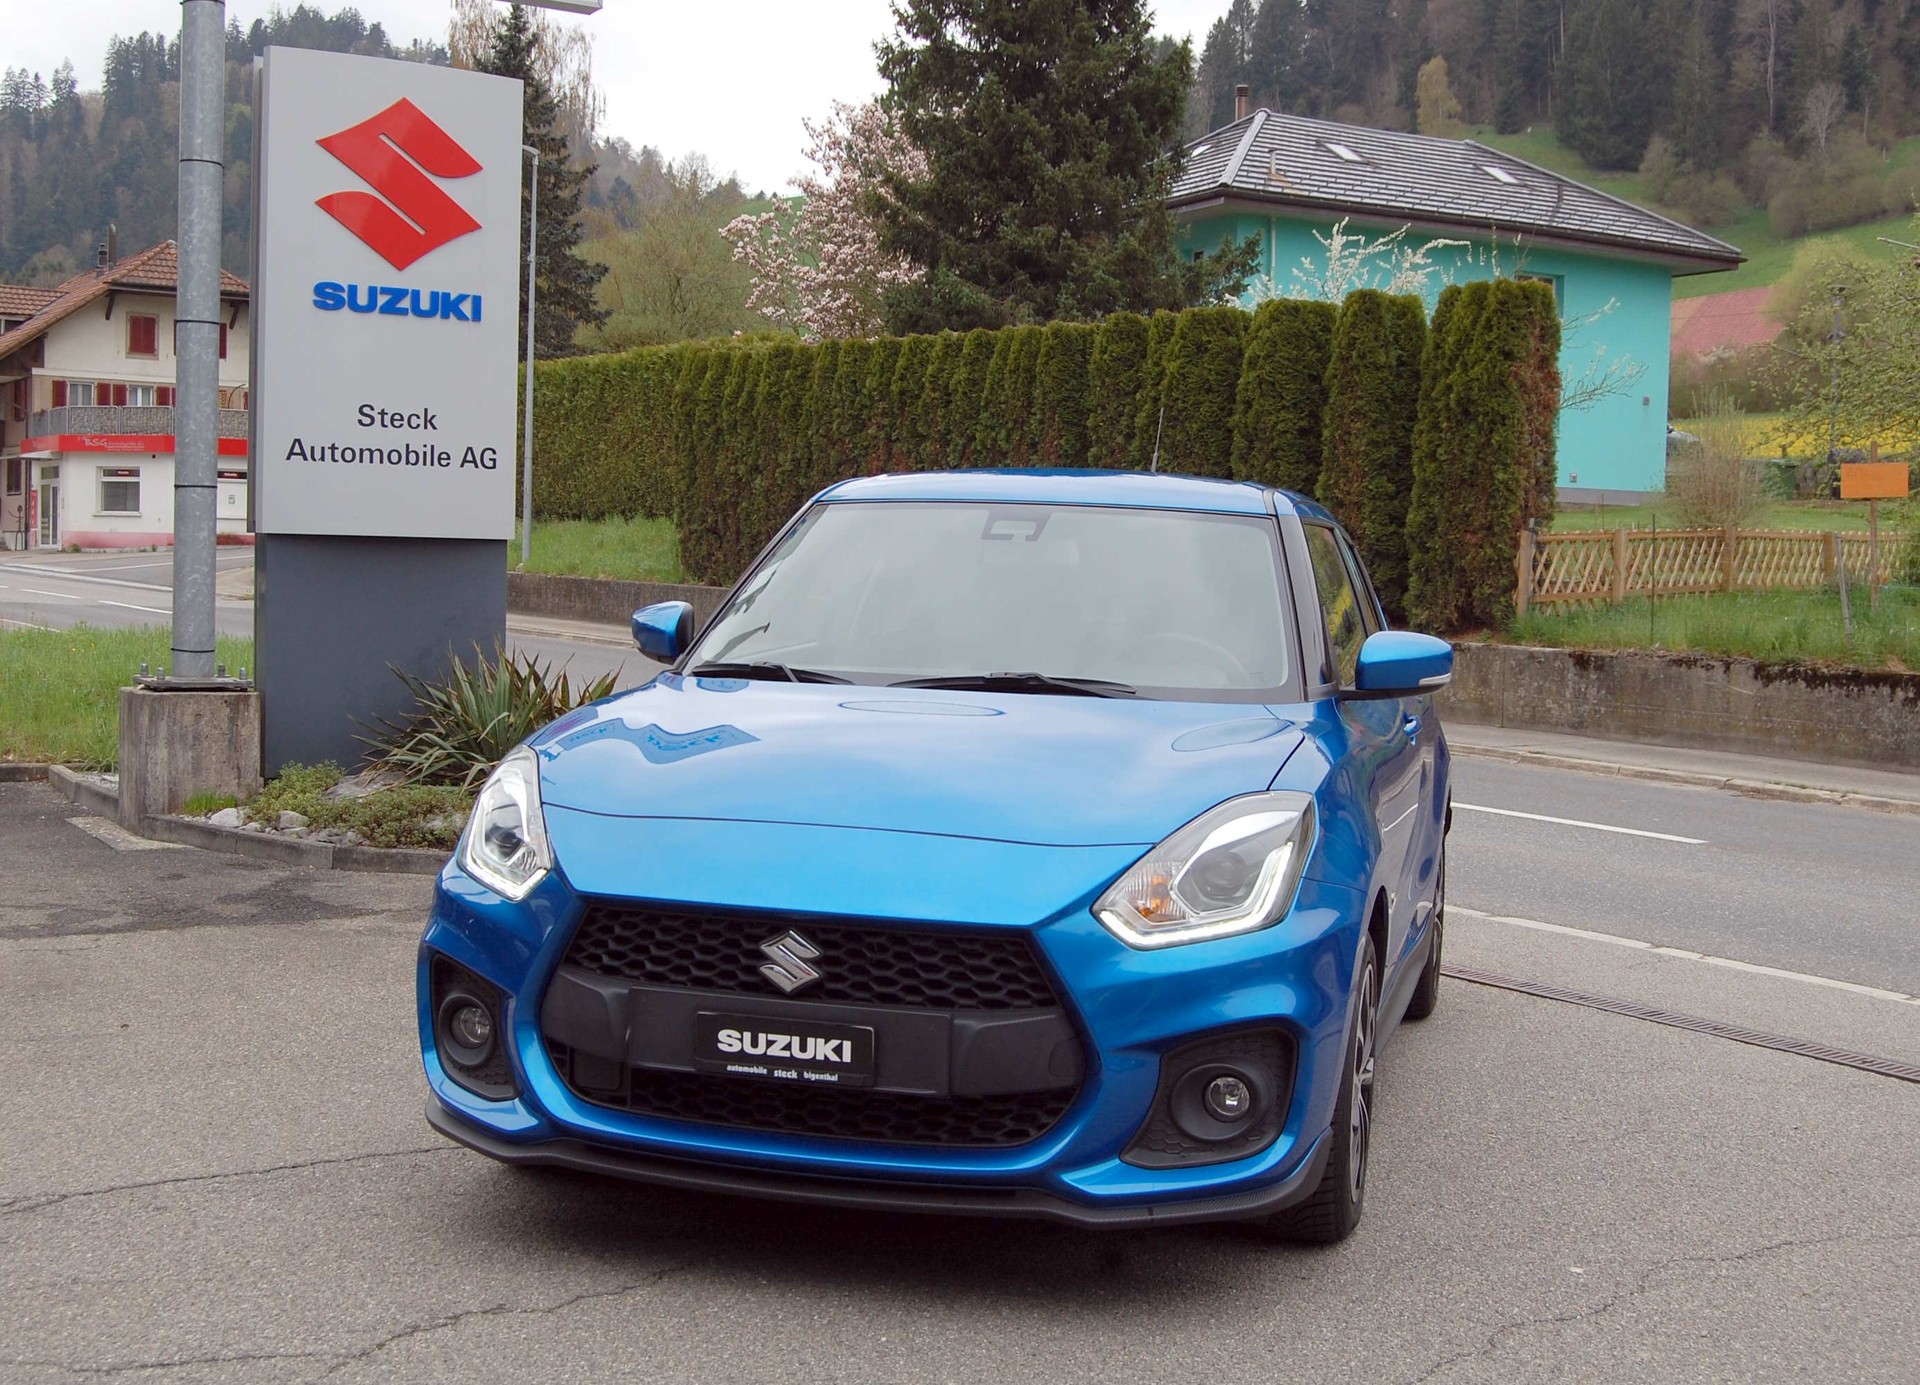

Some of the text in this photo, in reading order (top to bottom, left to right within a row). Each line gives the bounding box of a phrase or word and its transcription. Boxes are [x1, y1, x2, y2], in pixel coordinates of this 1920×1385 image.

[313, 281, 483, 322] SUZUKI
[358, 403, 438, 431] Steck
[286, 438, 497, 470] Automobile AG
[717, 1029, 852, 1063] SUZUKI
[726, 1064, 839, 1082] automobile steck bigenthal
